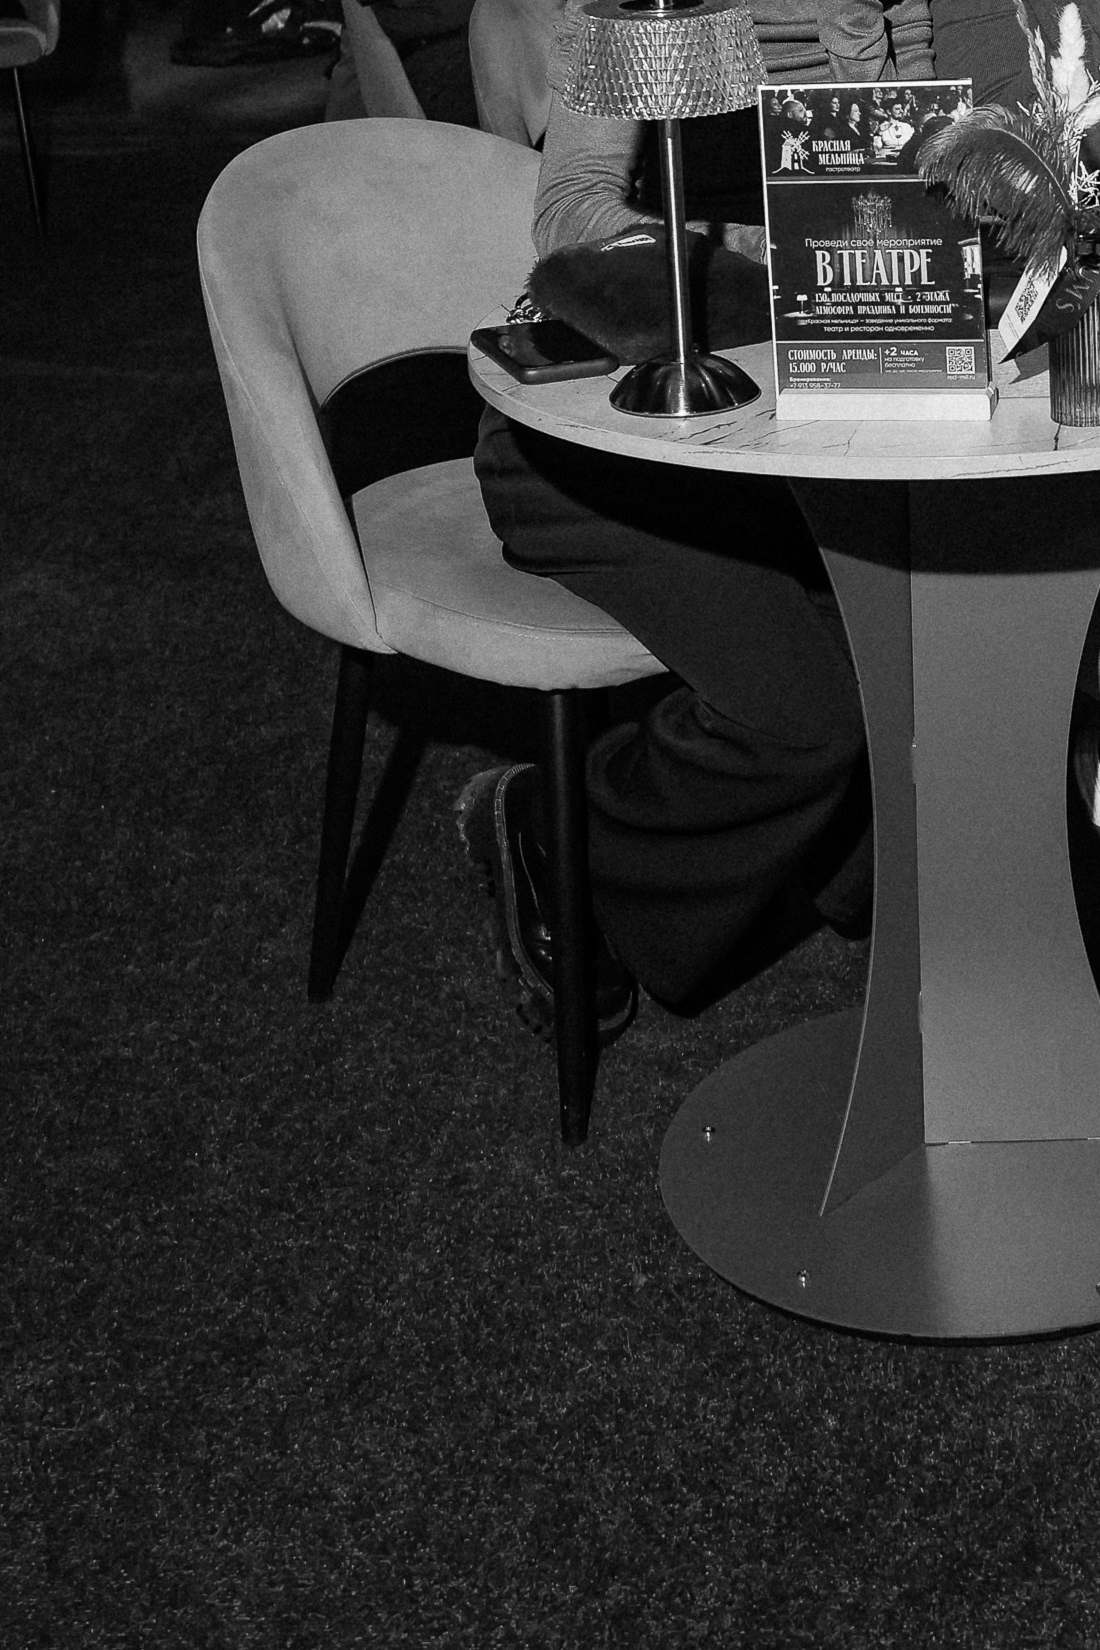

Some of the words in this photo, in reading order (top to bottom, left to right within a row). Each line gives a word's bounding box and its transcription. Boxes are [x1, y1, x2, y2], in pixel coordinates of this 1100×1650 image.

[812, 140, 851, 152] КРАСНАЯ
[818, 153, 865, 165] МЕЛЬНИЦА
[805, 238, 849, 248] Проведи
[876, 238, 943, 248] мероприятие
[815, 250, 834, 286] В
[837, 249, 936, 286] ТЕАТРЕ
[831, 292, 881, 303] ПОСАДОЧНЫХ
[915, 292, 921, 302] 2
[925, 291, 951, 301] ЭТАЖА
[815, 305, 854, 315] АТМОСФЕРА
[857, 305, 897, 315] ПРАЗДНИКА
[900, 305, 906, 314] И
[909, 304, 952, 314] БОГЕМНОСТИ
[884, 325, 935, 333] одновременно
[788, 349, 837, 360] СТОИМОСТЬ
[842, 349, 878, 361] АРЕНДЫ:
[884, 347, 898, 356] +2
[789, 362, 817, 373] 15.000
[821, 362, 847, 373] Р/ЧАС
